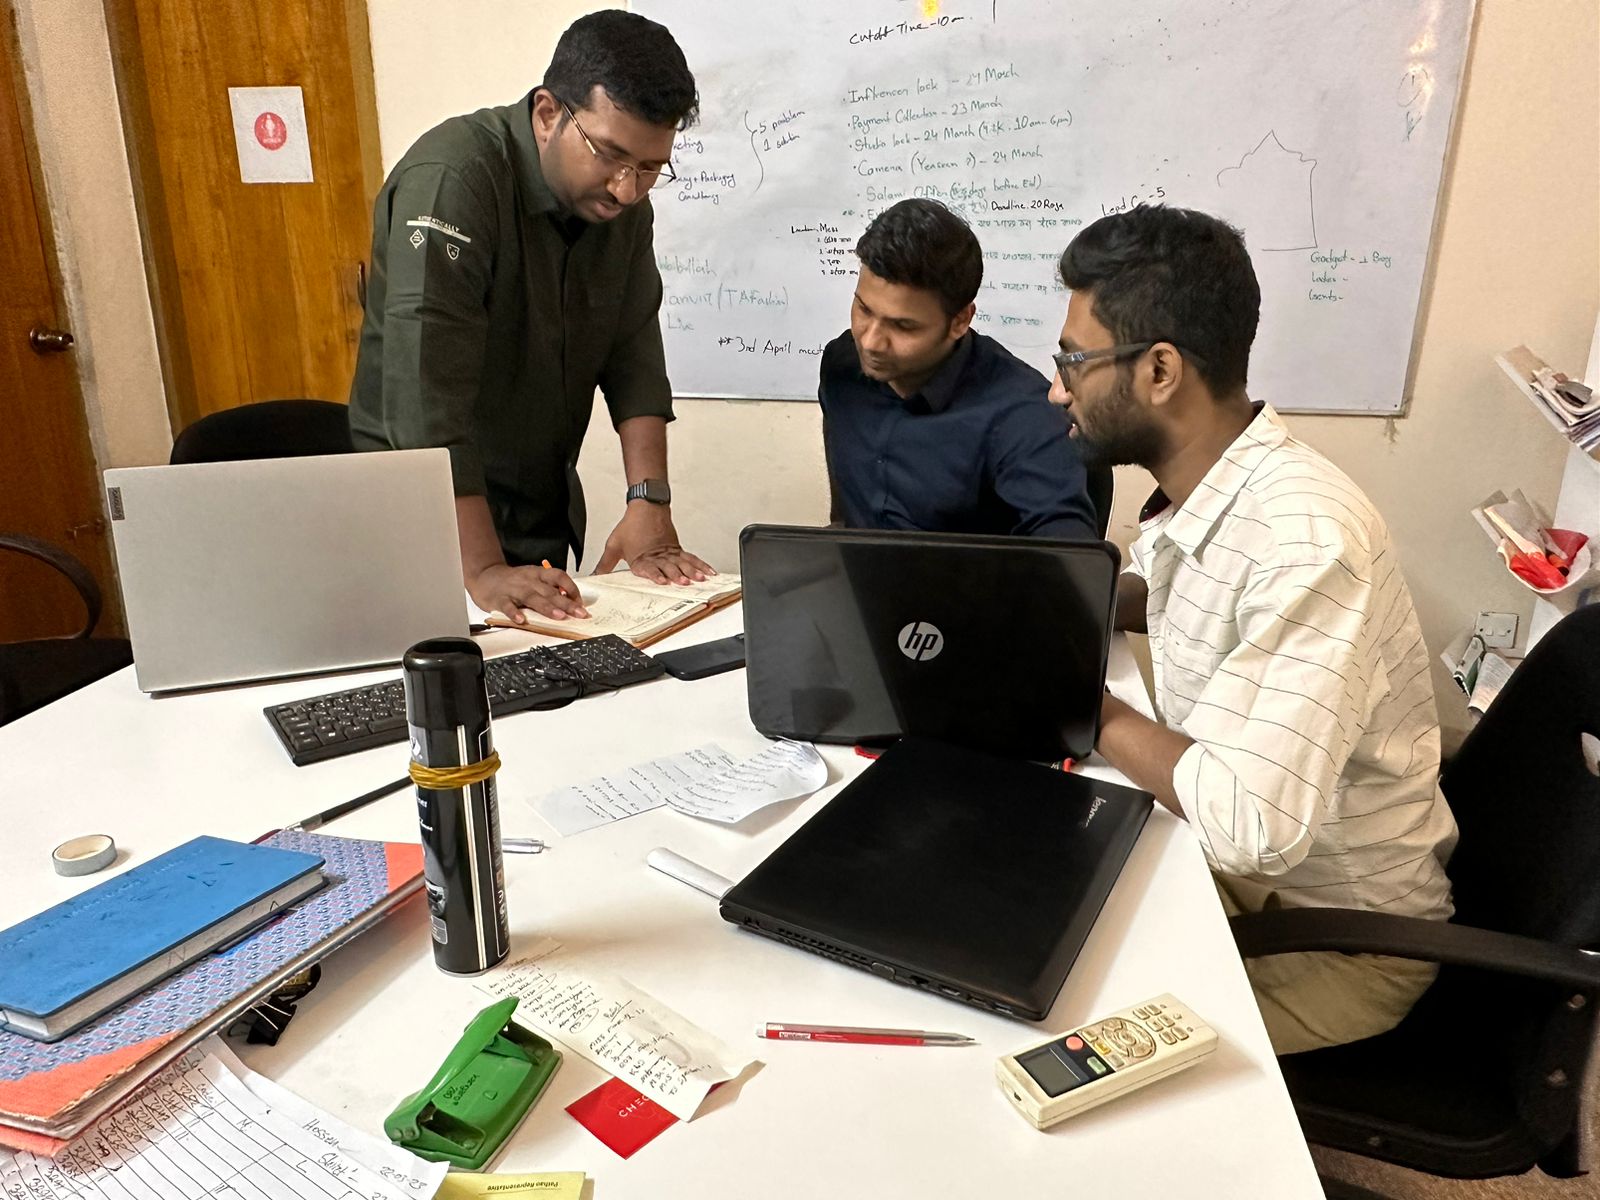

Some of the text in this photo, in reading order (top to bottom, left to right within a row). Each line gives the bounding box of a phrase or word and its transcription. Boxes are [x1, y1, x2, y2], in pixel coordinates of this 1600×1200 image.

[917, 77, 939, 95] lock
[952, 102, 968, 115] 23
[924, 130, 939, 142] 24
[943, 124, 976, 142] March
[992, 150, 1008, 164] 24
[1011, 145, 1044, 161] March
[1156, 186, 1166, 198] 5
[1031, 199, 1043, 210] 20
[762, 339, 792, 357] April
[904, 621, 939, 661] hp
